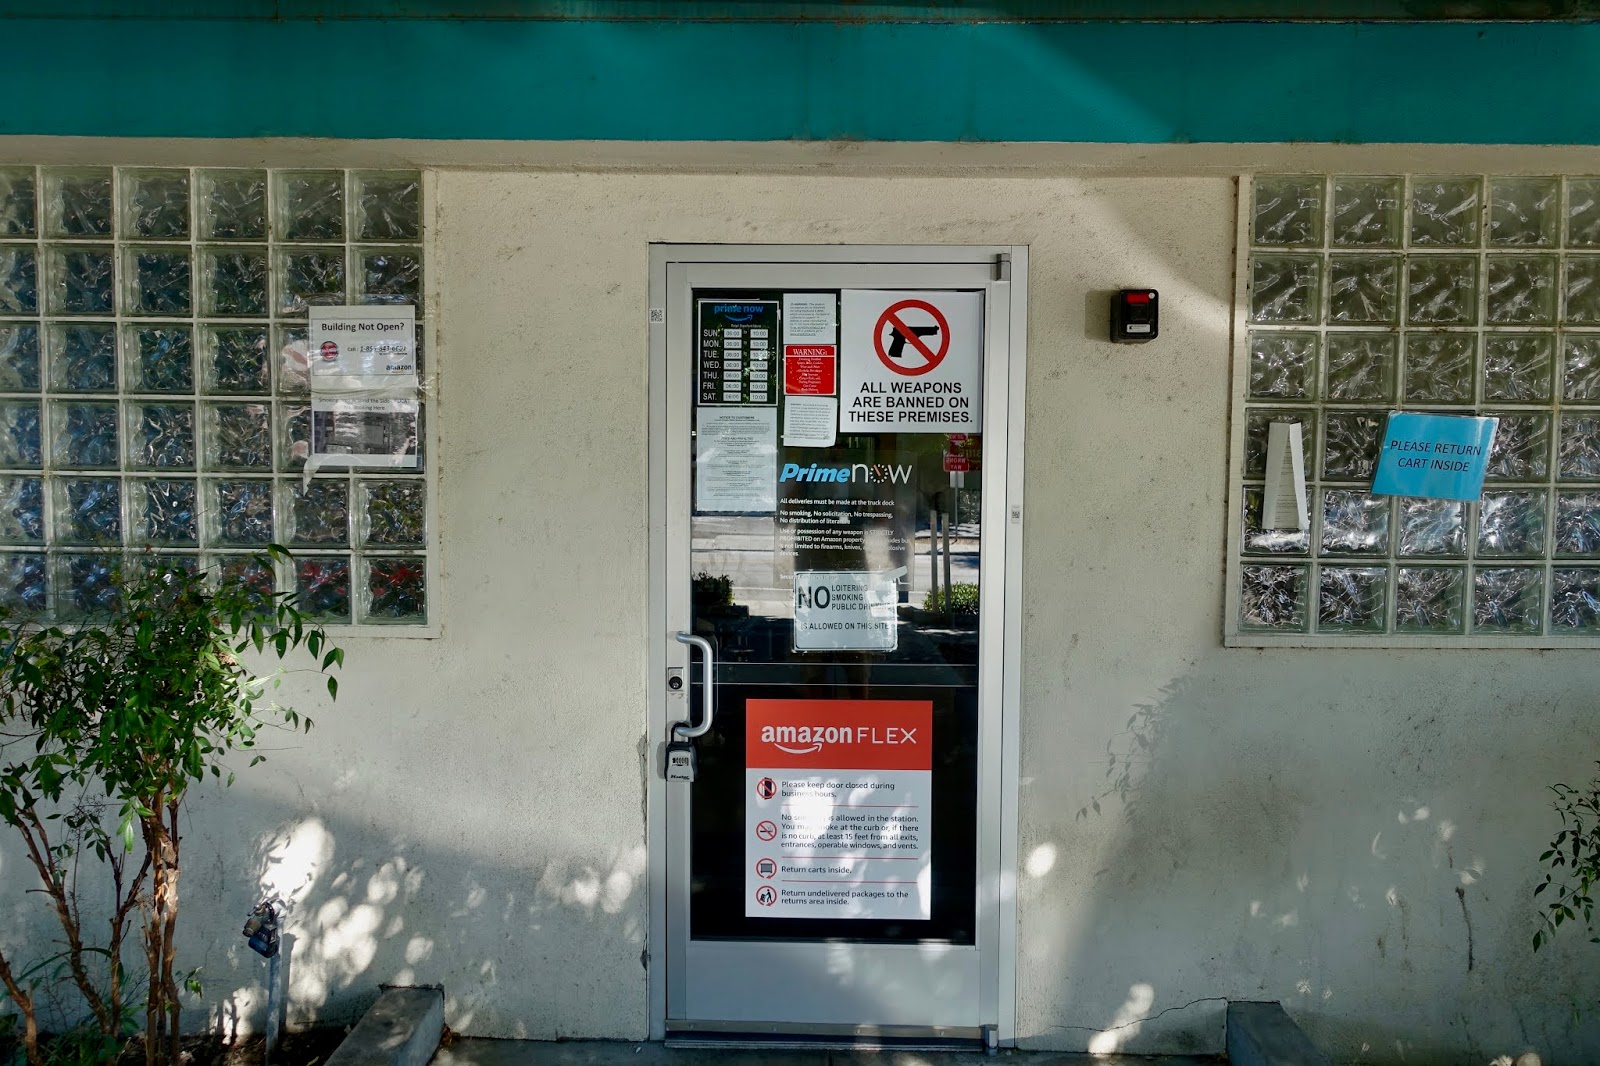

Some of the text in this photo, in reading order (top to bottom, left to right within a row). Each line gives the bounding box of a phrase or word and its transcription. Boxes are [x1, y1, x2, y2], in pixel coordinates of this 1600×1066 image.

[714, 304, 741, 314] prime
[322, 323, 404, 332] Building Not Open?
[704, 329, 720, 337] SUN.
[704, 340, 721, 348] MON.
[703, 350, 719, 359] TUE.
[704, 361, 721, 369] WED.
[702, 382, 716, 390] FRI.
[860, 382, 962, 394] ALL WEAPONS
[703, 393, 717, 401] SAT.
[853, 397, 969, 408] ARE BANNED ON
[849, 411, 973, 423] THESE PREMISES.
[1390, 441, 1482, 456] PLEASE RETURN
[1398, 458, 1470, 472] CART INSIDE
[798, 586, 831, 609] NO
[761, 726, 917, 744] amazon FLEX
[870, 782, 895, 791] during
[799, 833, 817, 841] curb,
[900, 834, 919, 842] exits,
[850, 842, 882, 850] windows,
[828, 866, 852, 874] inside.
[782, 889, 806, 897] Return
[852, 890, 886, 899] packages
